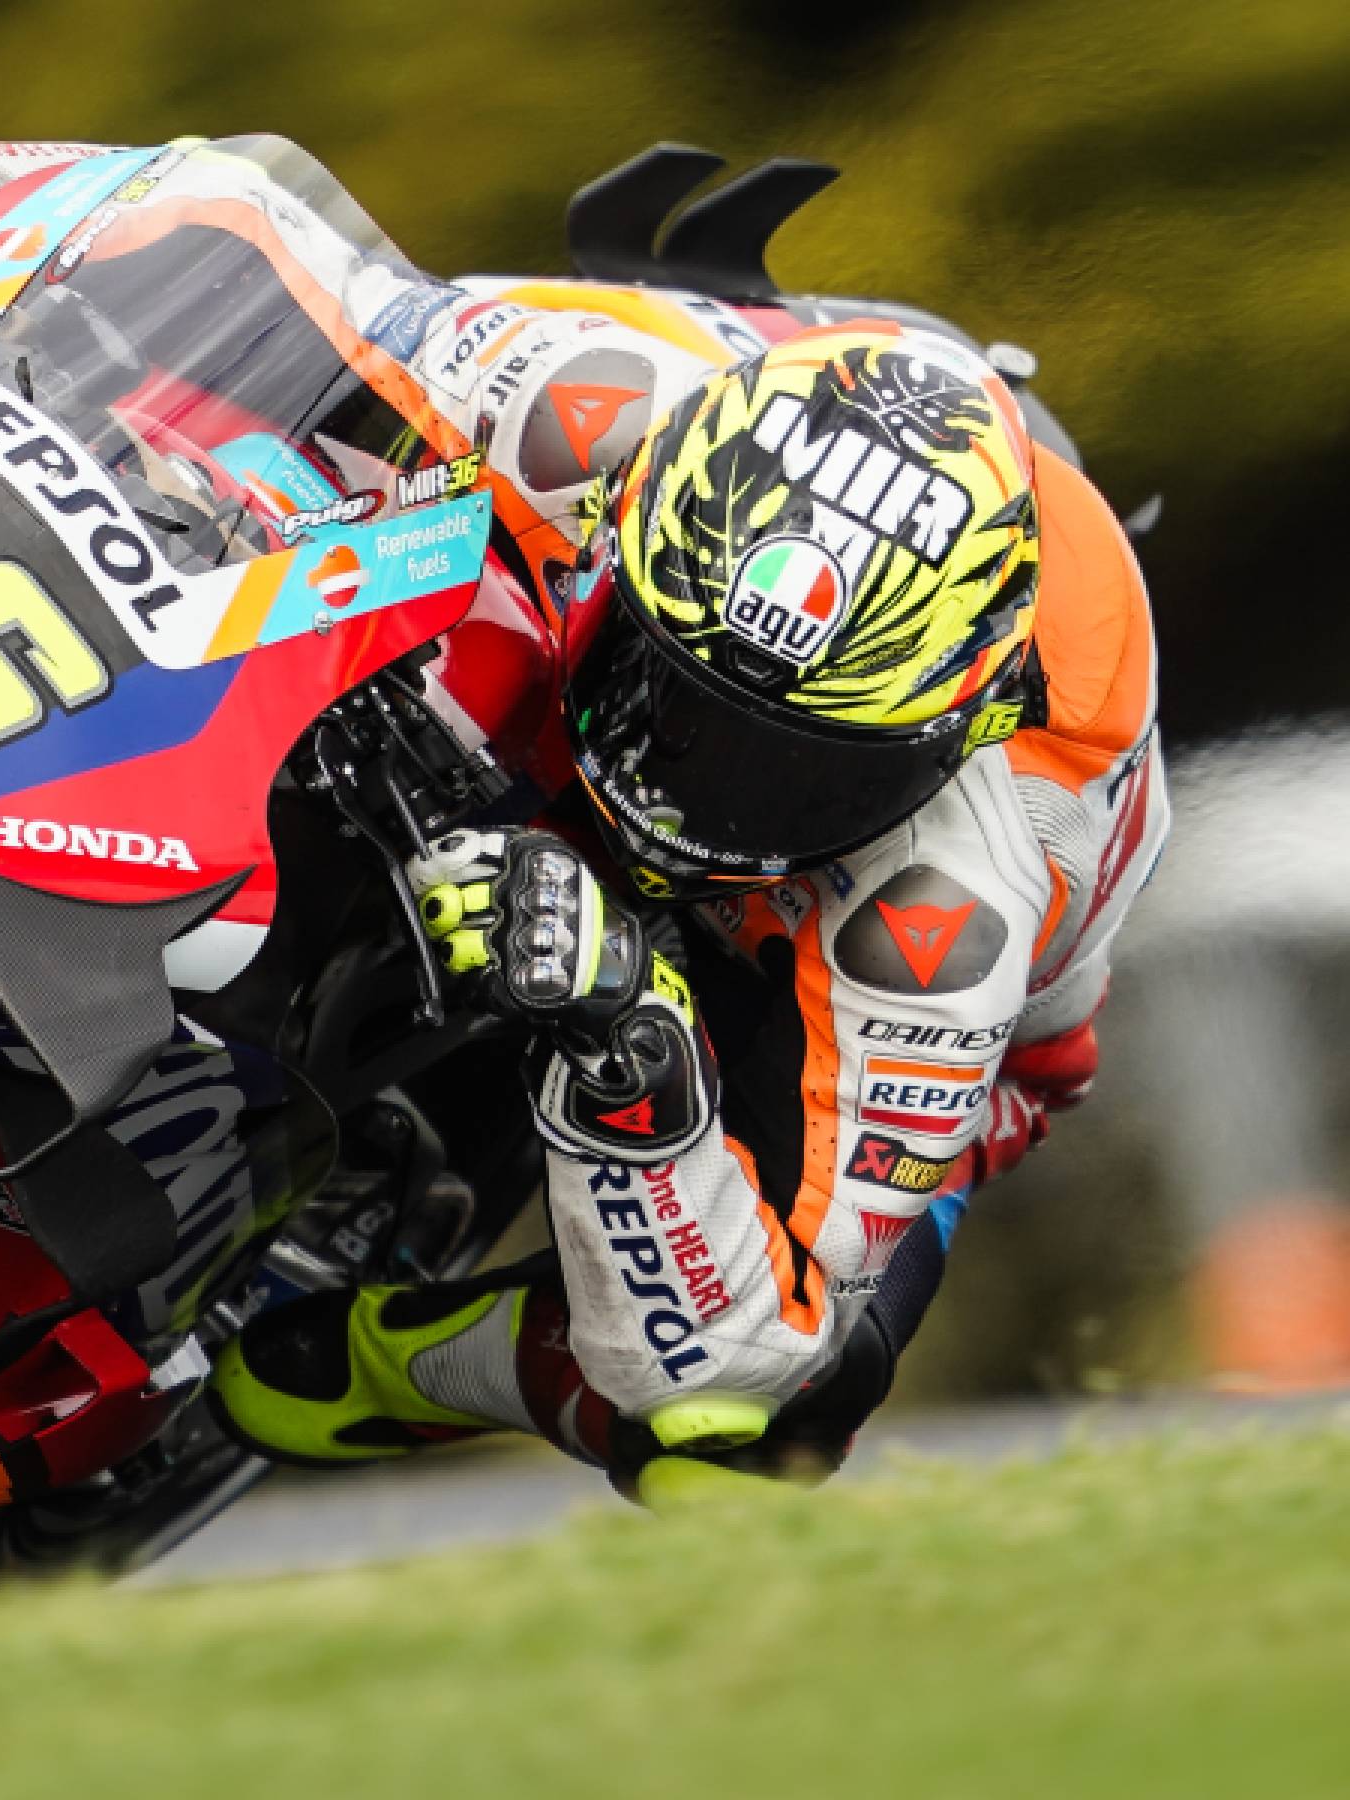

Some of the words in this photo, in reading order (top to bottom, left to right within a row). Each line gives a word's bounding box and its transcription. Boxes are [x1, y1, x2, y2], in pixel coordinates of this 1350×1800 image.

[753, 396, 969, 563] MIR
[377, 512, 472, 560] Renewable
[407, 551, 451, 582] fuels
[867, 1082, 988, 1111] REPSO
